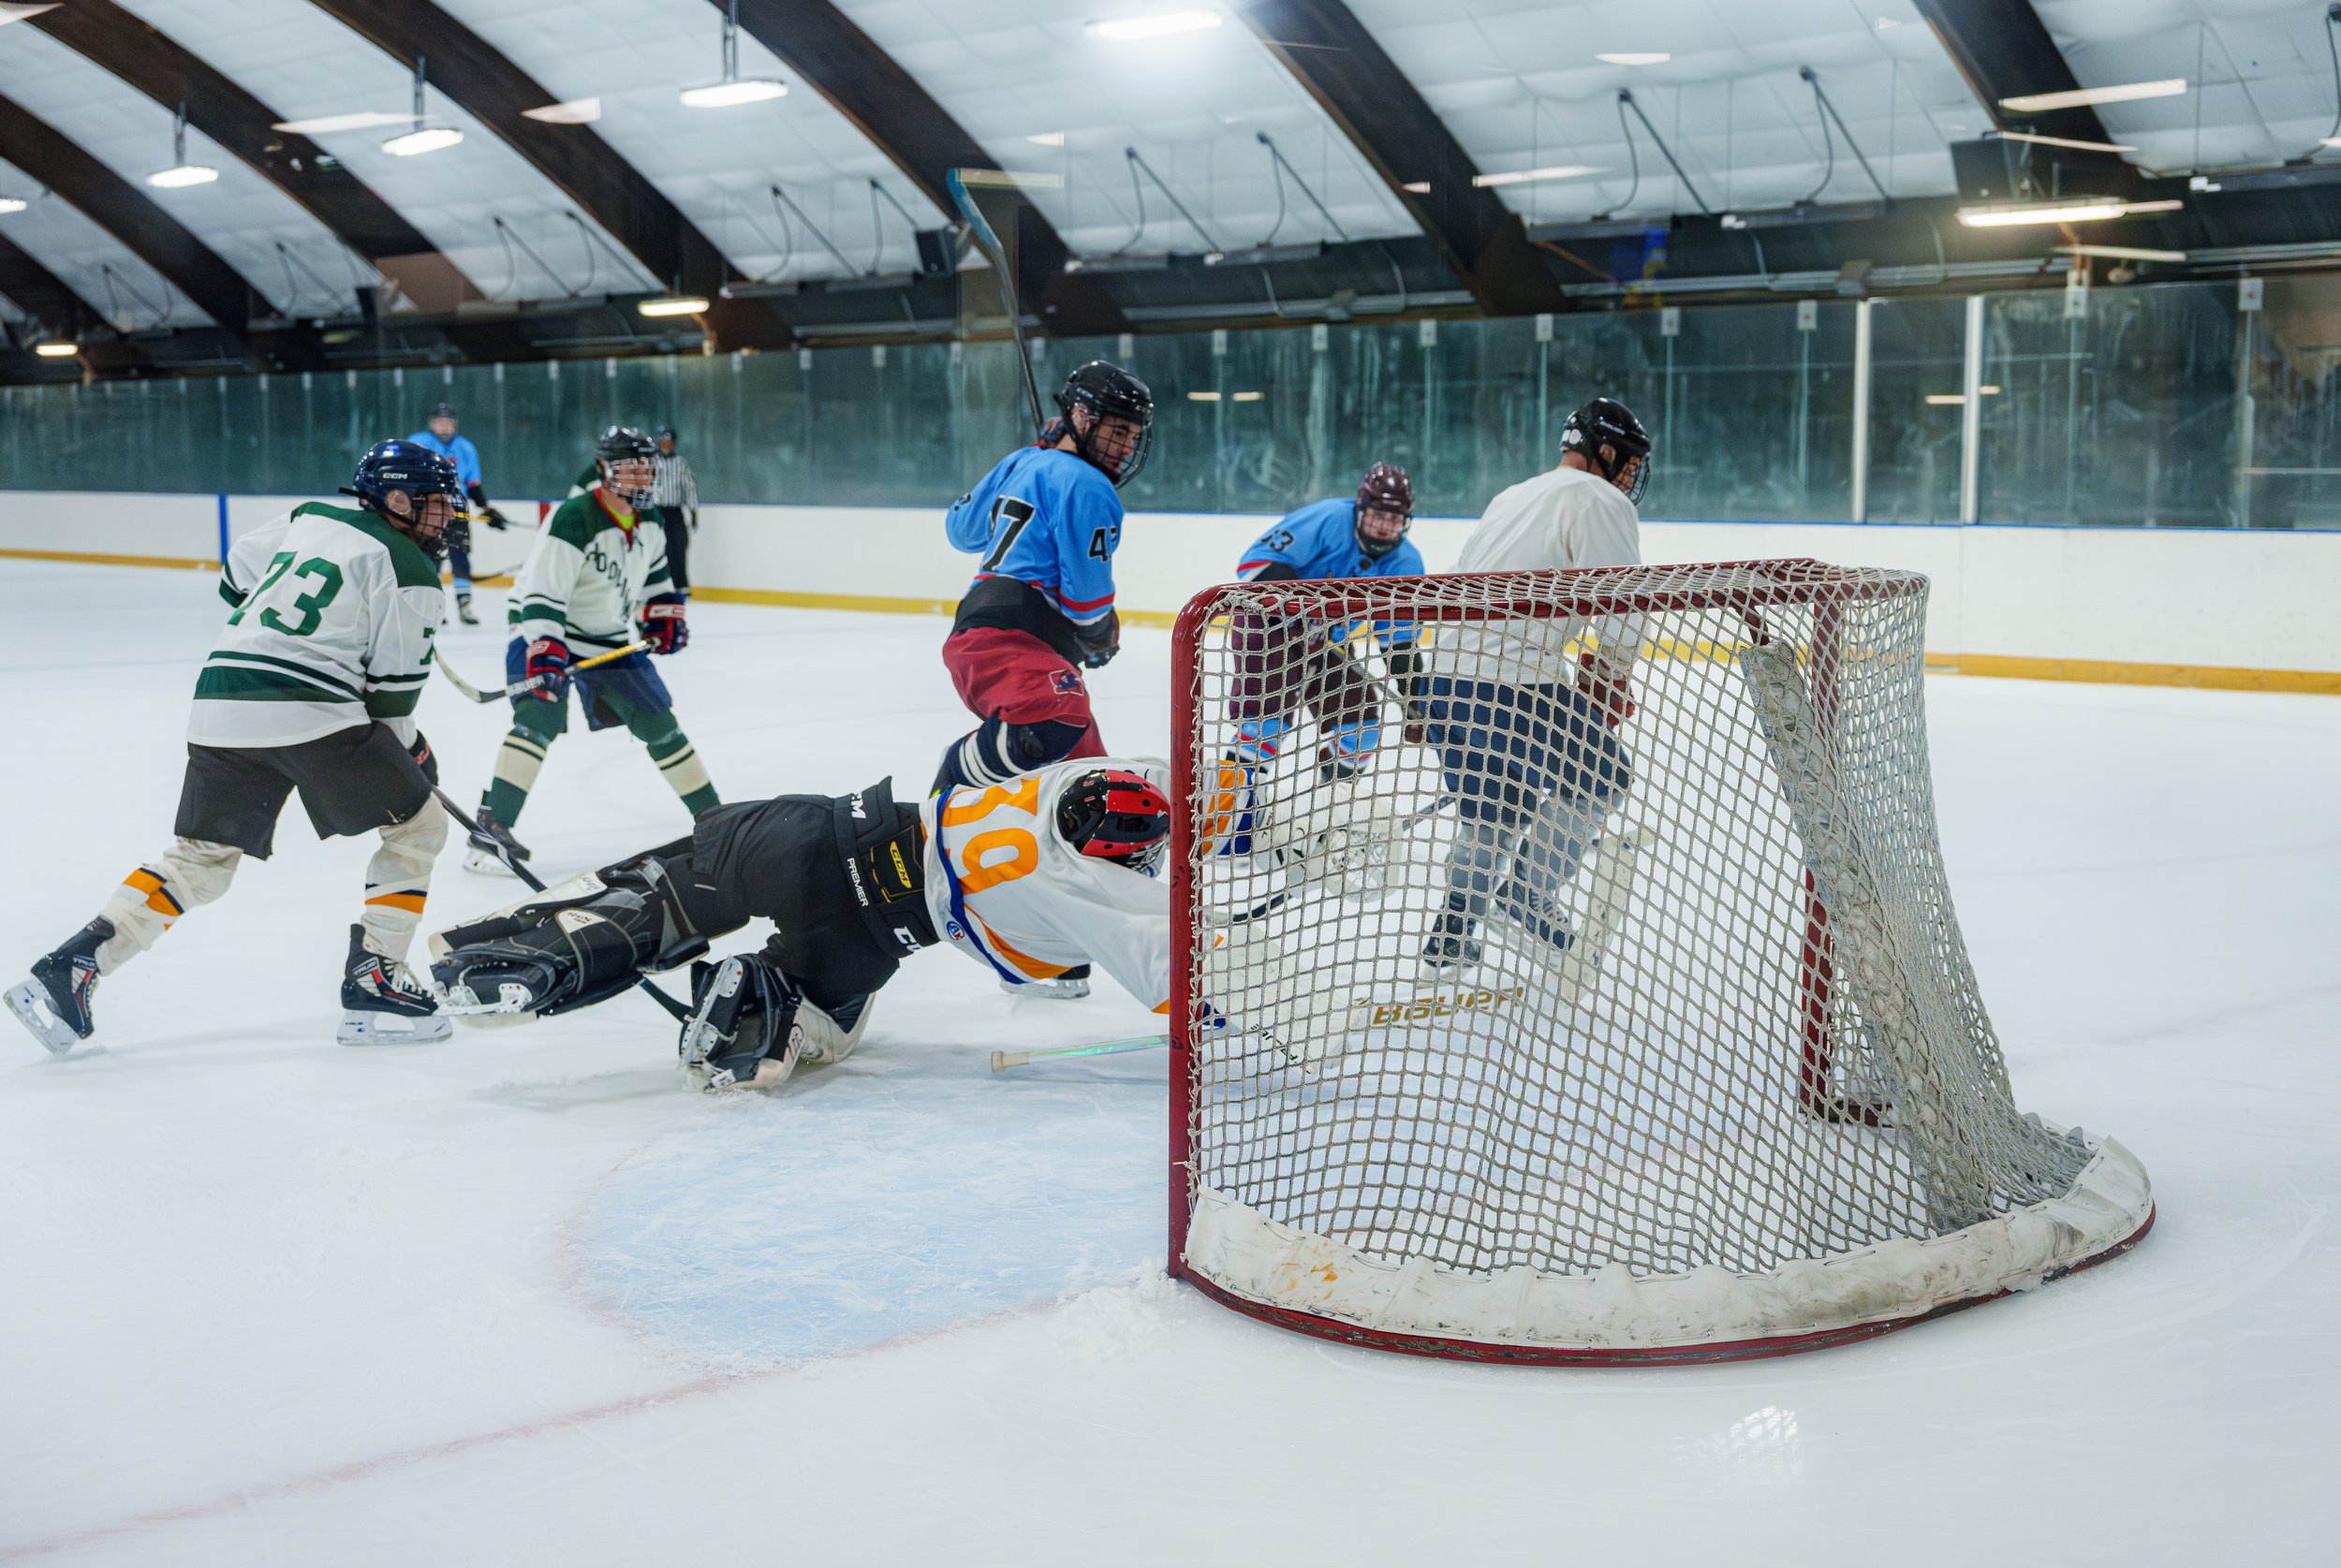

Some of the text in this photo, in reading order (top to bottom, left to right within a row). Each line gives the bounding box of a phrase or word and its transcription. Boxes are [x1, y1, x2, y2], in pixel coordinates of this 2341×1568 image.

[981, 494, 1036, 573] 7
[228, 551, 345, 637] 73
[847, 857, 869, 907] PREMIER
[891, 849, 909, 883] CCM
[1372, 987, 1524, 1025] BAUER
